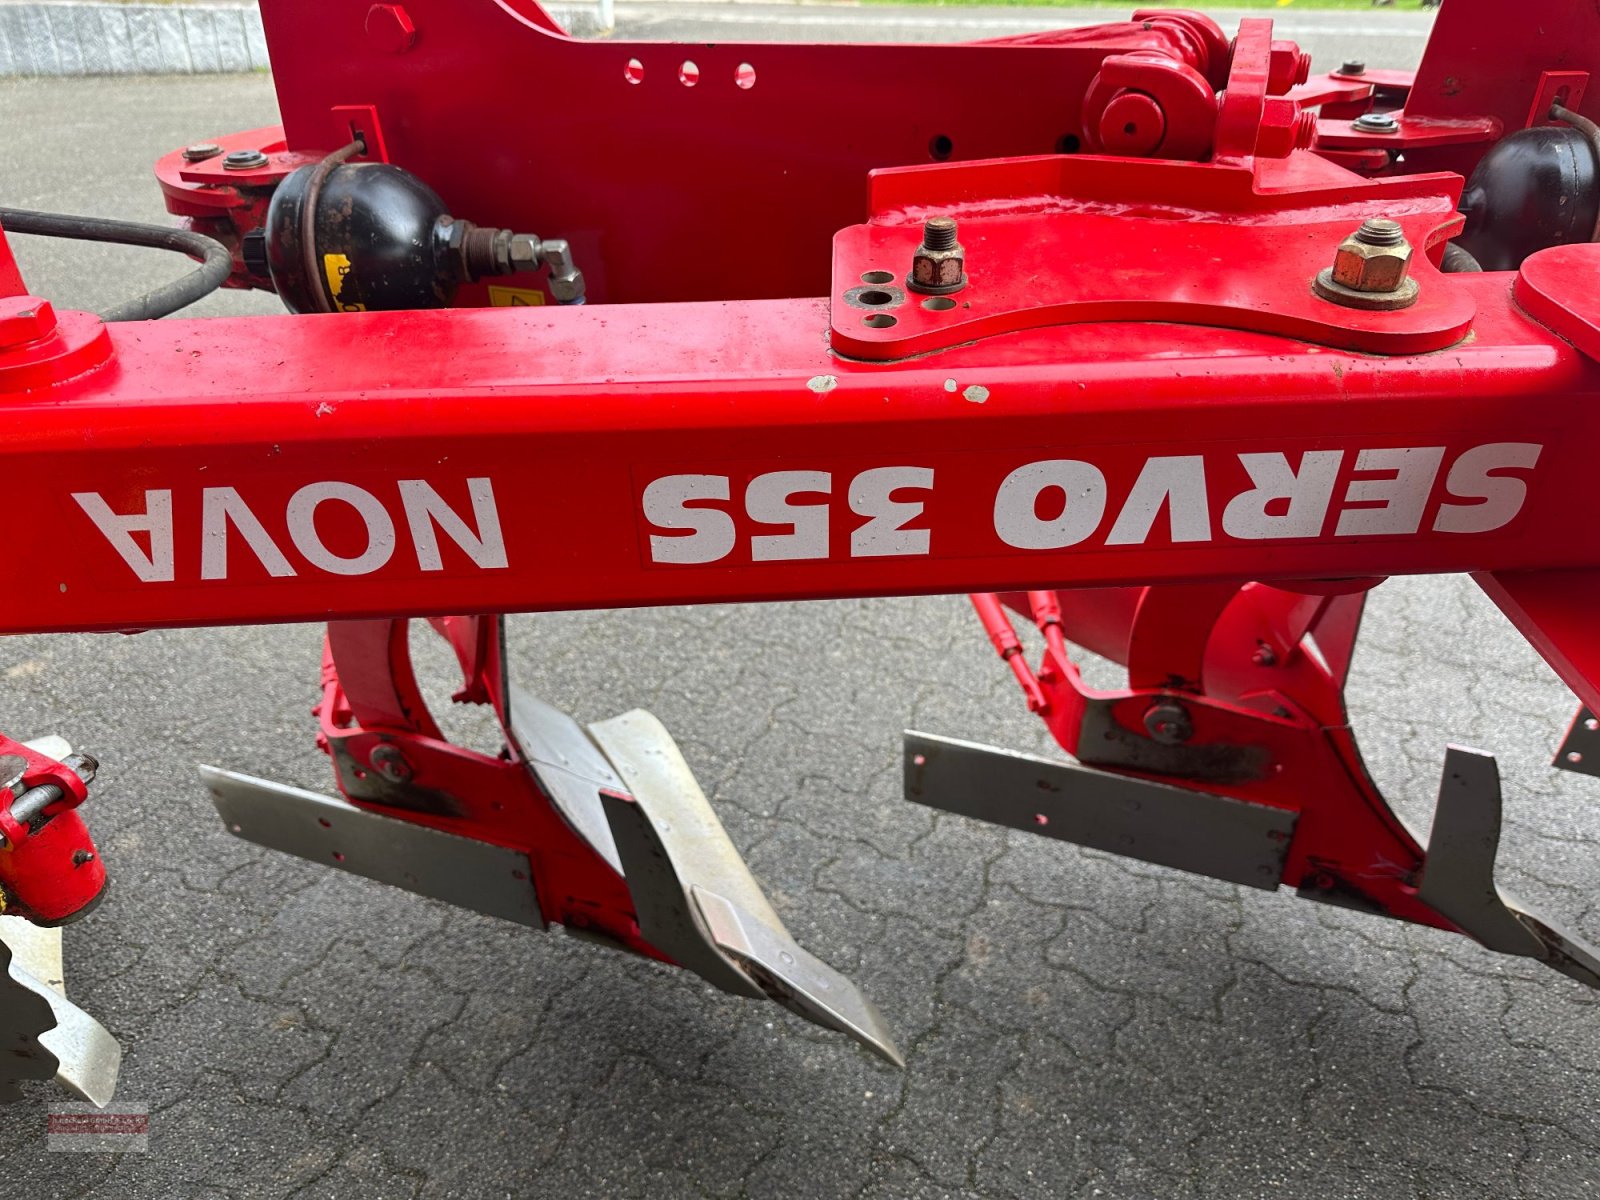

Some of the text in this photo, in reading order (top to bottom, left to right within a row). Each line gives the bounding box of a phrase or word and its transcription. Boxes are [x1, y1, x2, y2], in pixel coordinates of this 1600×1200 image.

[73, 443, 1542, 582] SERVO 35S NOVA
